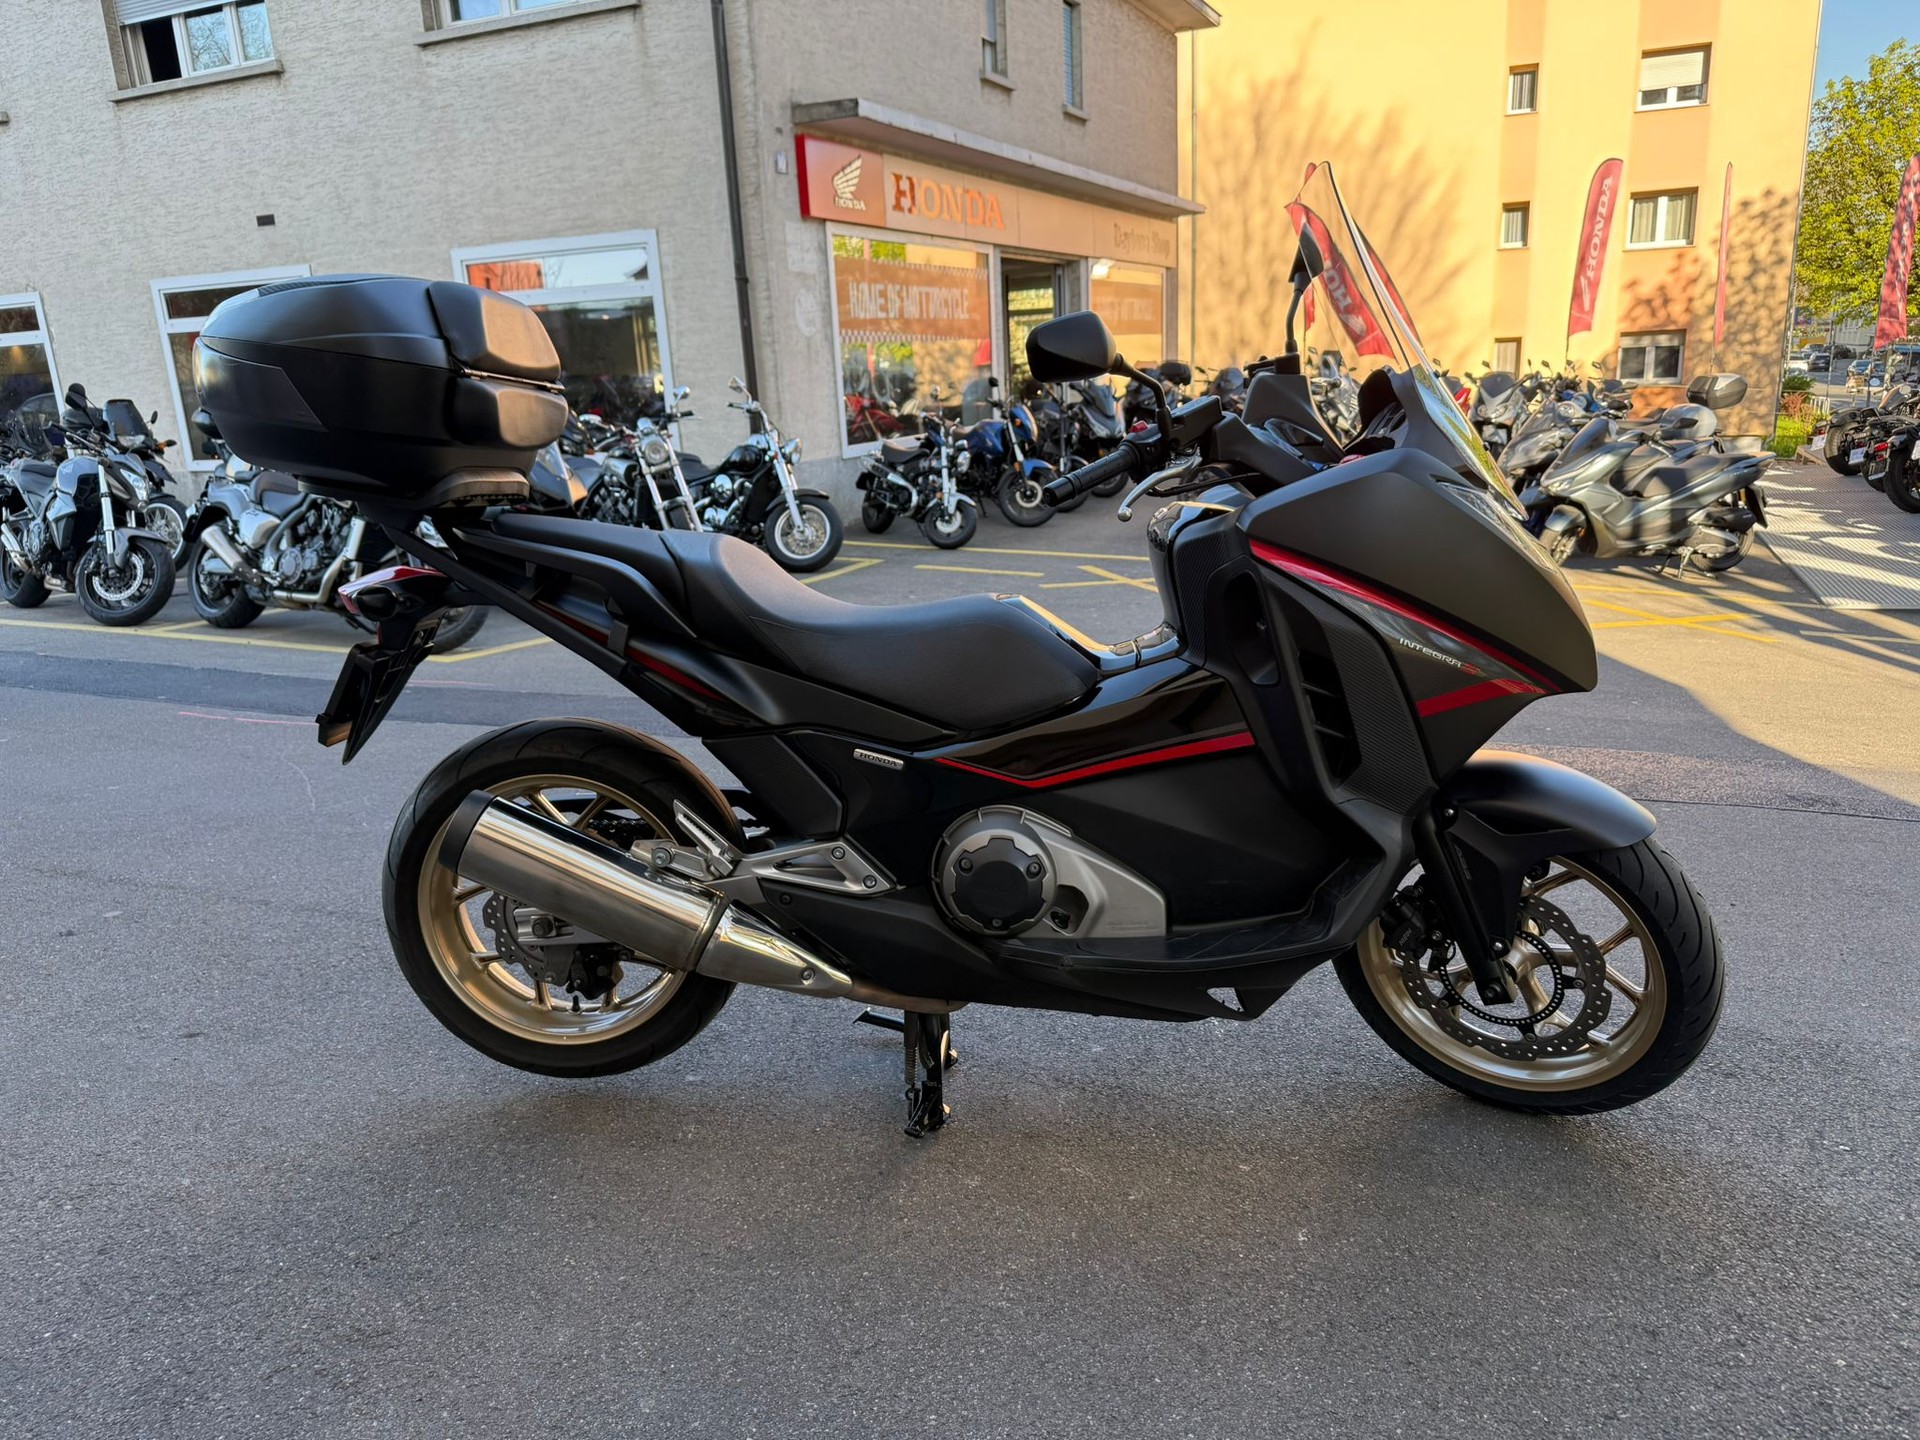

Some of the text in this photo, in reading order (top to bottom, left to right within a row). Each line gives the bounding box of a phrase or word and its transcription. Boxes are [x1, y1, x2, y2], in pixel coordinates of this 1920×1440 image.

[834, 197, 866, 211] HONDA
[891, 172, 1006, 231] HONDA
[1586, 176, 1613, 279] HONDA
[849, 281, 887, 319] HOME
[887, 283, 901, 318] OF
[1399, 637, 1461, 668] INTEGRA
[859, 752, 897, 767] HONDA
